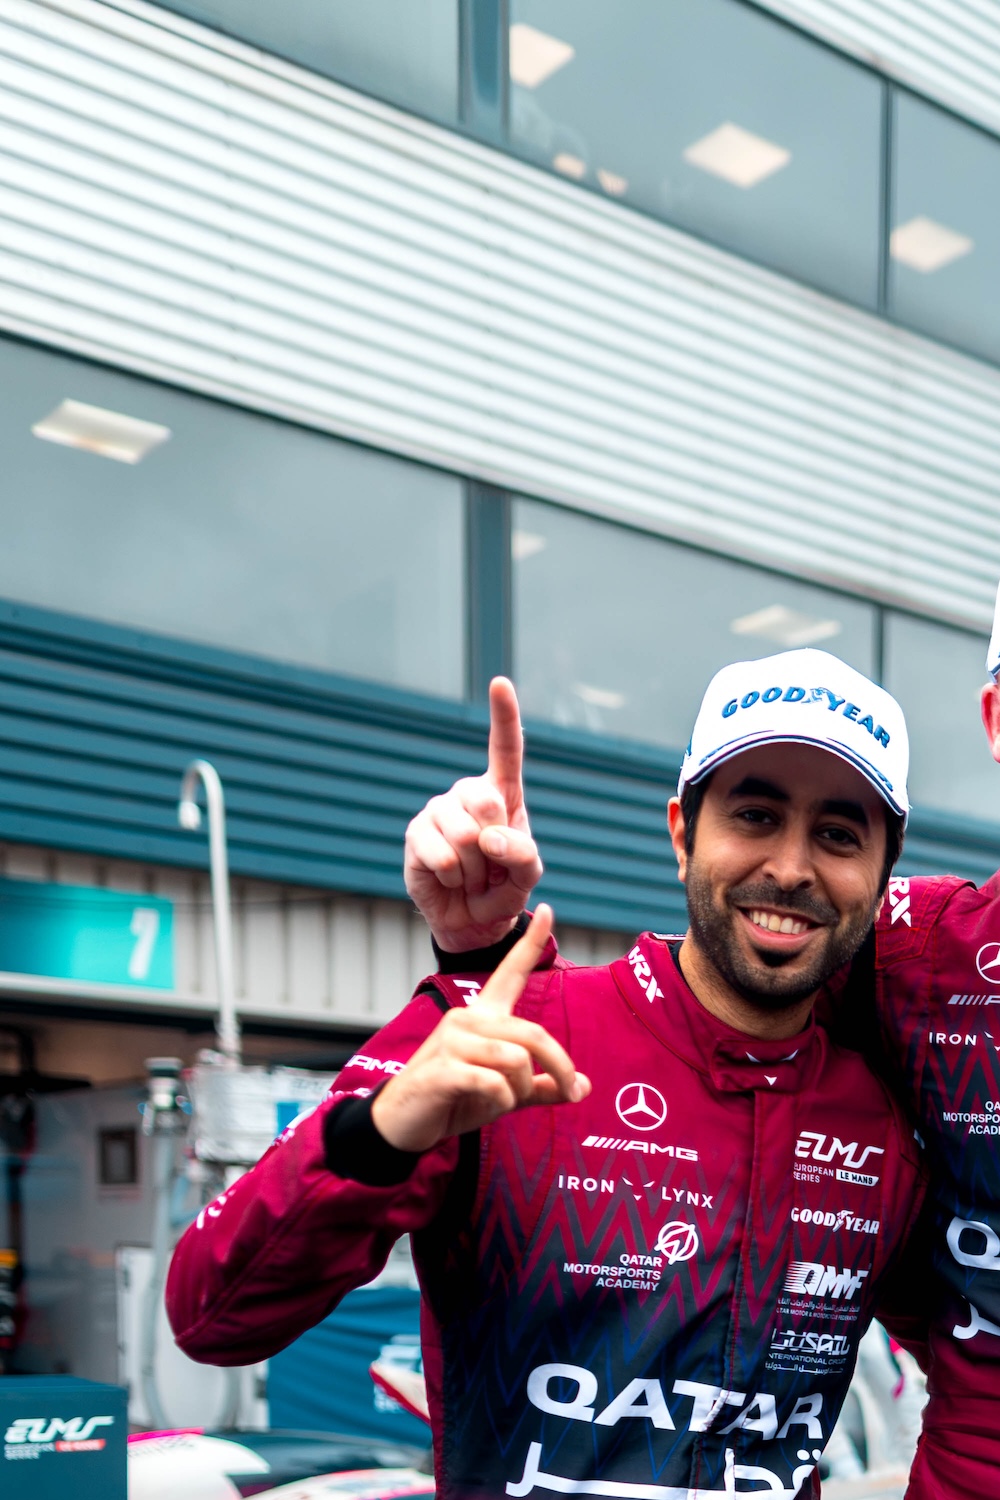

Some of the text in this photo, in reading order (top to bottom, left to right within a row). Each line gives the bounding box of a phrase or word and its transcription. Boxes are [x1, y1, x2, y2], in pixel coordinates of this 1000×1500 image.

[628, 946, 665, 1004] HRX
[929, 1032, 977, 1046] IRON
[623, 1140, 698, 1162] AMG
[851, 1173, 873, 1186] MANS
[558, 1174, 714, 1209] IRON LYNX
[620, 1254, 663, 1267] QATAR
[563, 1262, 662, 1281] MOTORSPORTS
[596, 1277, 660, 1291] ACADEMY
[526, 1363, 824, 1441] QATAR
